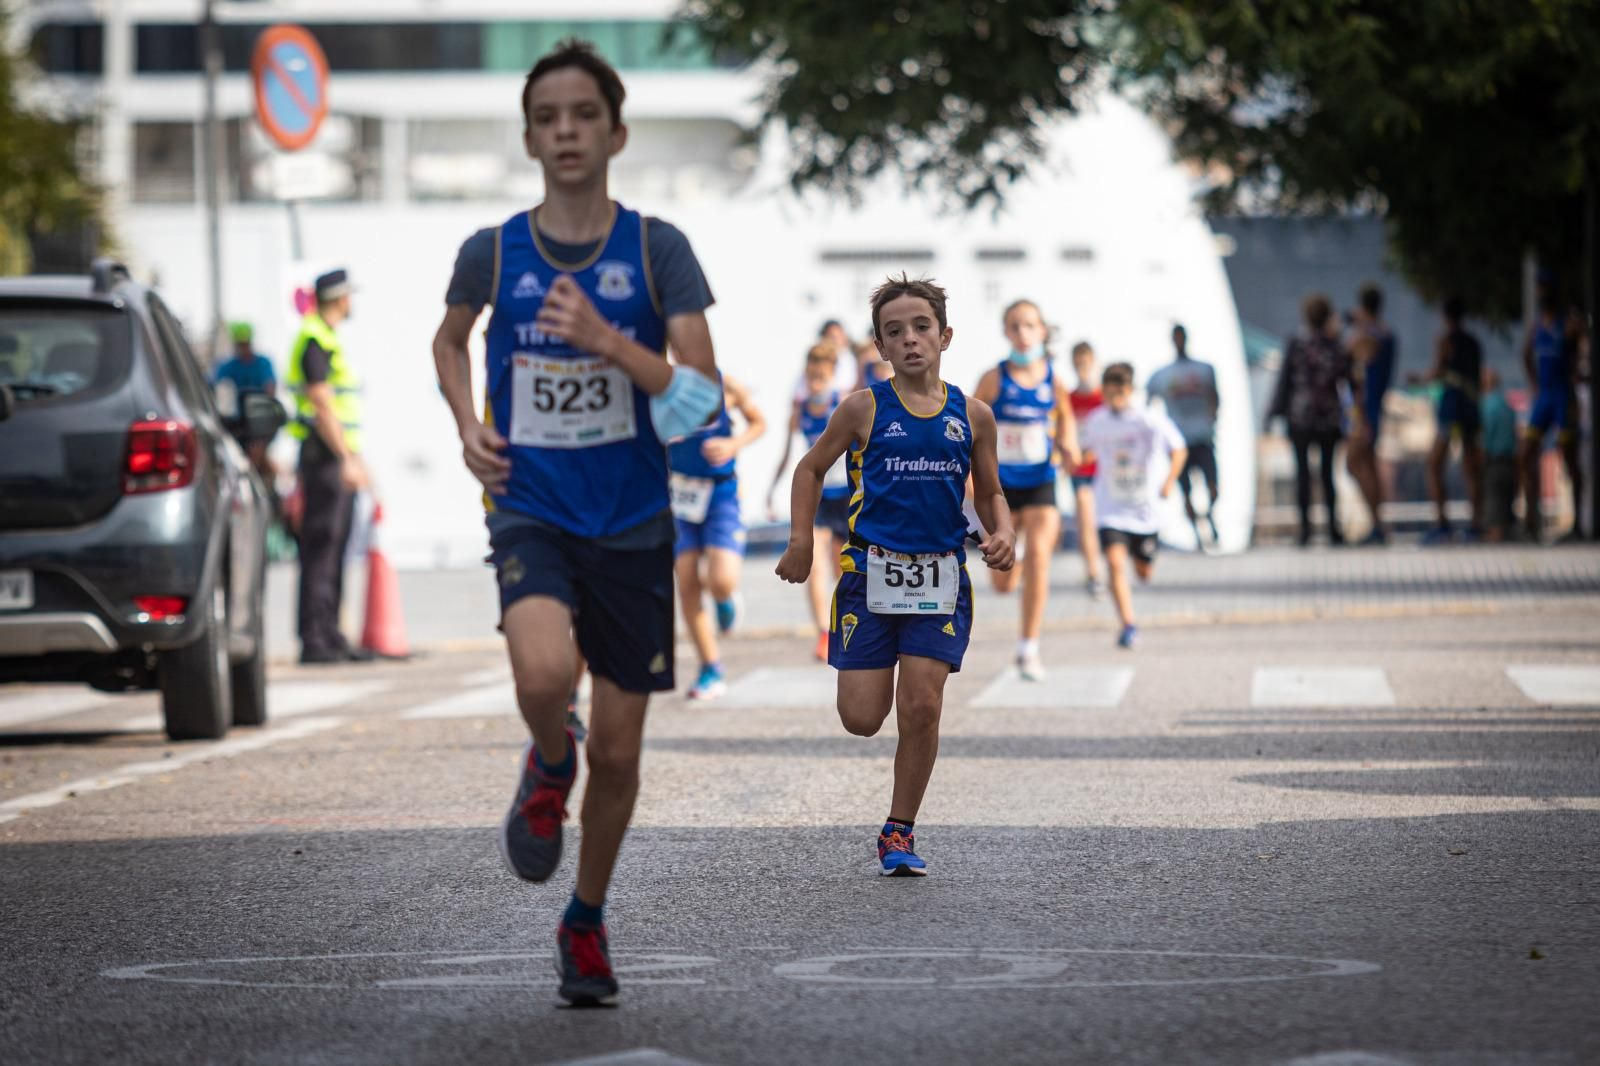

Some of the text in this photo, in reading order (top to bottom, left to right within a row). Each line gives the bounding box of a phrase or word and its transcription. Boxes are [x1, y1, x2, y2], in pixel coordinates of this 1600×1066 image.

[533, 376, 610, 413] 523
[884, 457, 962, 474] Tirabuzón
[885, 560, 939, 588] 531
